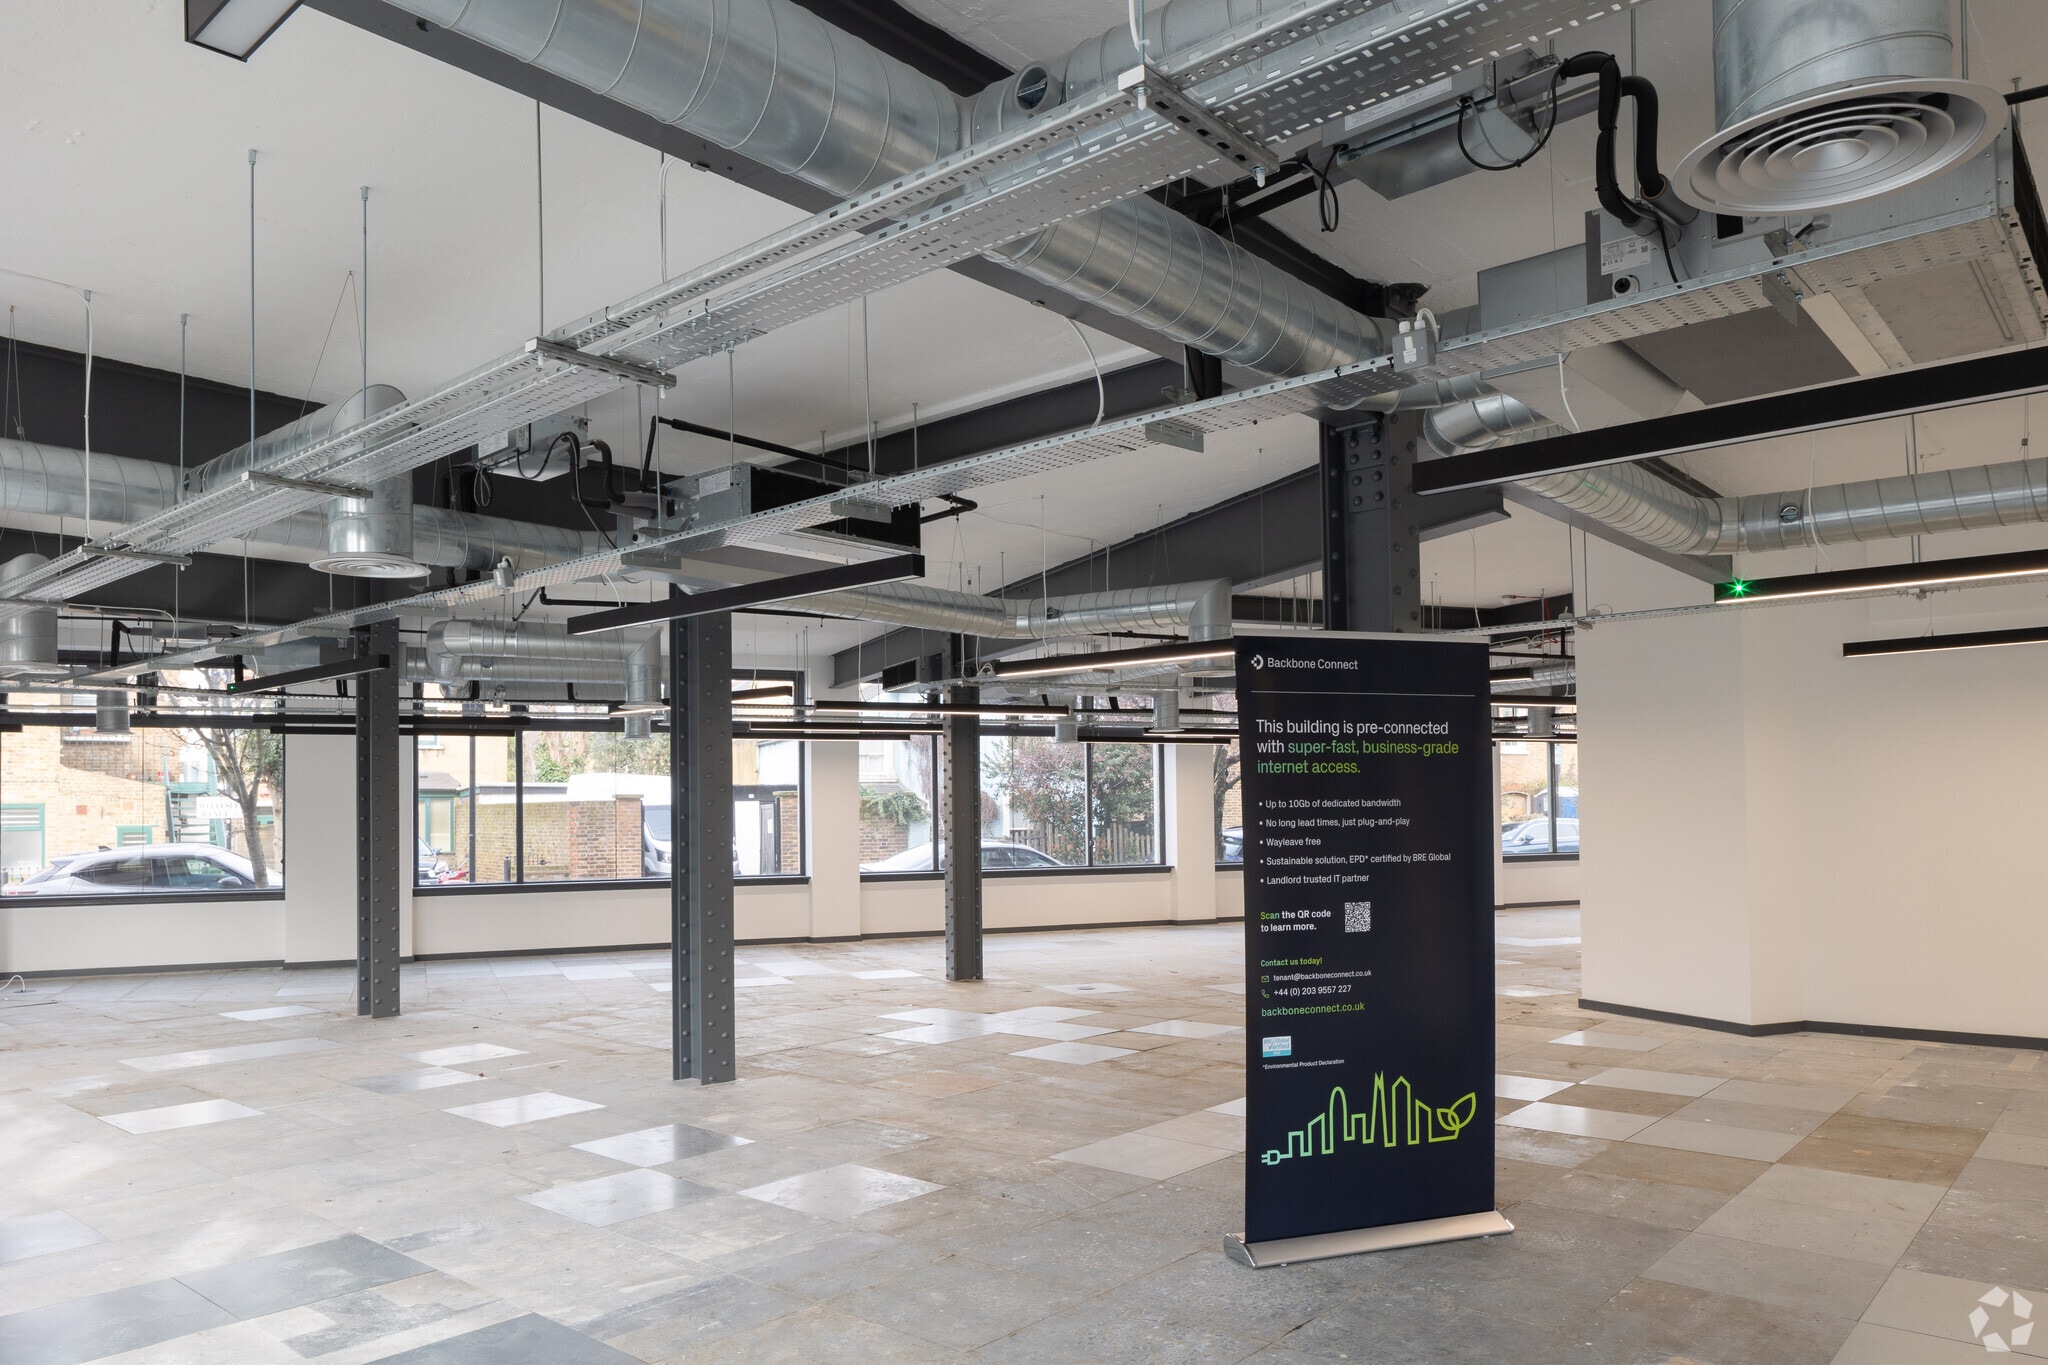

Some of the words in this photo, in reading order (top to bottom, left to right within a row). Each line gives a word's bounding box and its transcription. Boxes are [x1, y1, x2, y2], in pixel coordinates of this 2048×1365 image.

[1267, 658, 1316, 669] Backbone
[1317, 659, 1358, 670] Connect
[1256, 719, 1284, 734] This
[1287, 720, 1340, 736] building
[1343, 721, 1354, 734] is
[1356, 721, 1449, 736] pre-connected
[1257, 740, 1285, 754] with
[1288, 740, 1359, 756] super-fast,
[1362, 740, 1459, 757] business-grade
[1258, 760, 1309, 774] internet
[1311, 760, 1361, 774] access.
[1265, 799, 1277, 809] Up
[1288, 799, 1310, 808] 10Gb
[1312, 799, 1320, 808] of
[1322, 798, 1360, 808] dedicated
[1361, 798, 1401, 807] bandwidth
[1266, 818, 1277, 828] No
[1278, 818, 1296, 829] long
[1297, 818, 1316, 827] lead
[1317, 818, 1340, 828] times,
[1342, 817, 1356, 828] just
[1358, 817, 1410, 827] plug-and-play
[1266, 837, 1304, 848] Wayleave
[1305, 837, 1321, 846] free
[1266, 856, 1313, 866] Sustainable
[1314, 855, 1348, 865] solution,
[1370, 854, 1402, 863] certified
[1403, 853, 1412, 864] by
[1412, 853, 1427, 862] BRE
[1428, 852, 1451, 861] Global
[1267, 875, 1302, 885] Landlord
[1303, 875, 1332, 884] trusted
[1333, 875, 1340, 883] IT
[1342, 874, 1370, 884] partner
[1260, 911, 1280, 920] Scan
[1281, 911, 1296, 919] the
[1297, 910, 1310, 919] QR
[1311, 910, 1332, 918] code
[1270, 924, 1291, 932] learn
[1300, 957, 1323, 966] today!
[1273, 969, 1372, 982] tenant@backboneconnect.co.uk
[1290, 988, 1301, 997] (0)
[1302, 987, 1317, 995] 203
[1318, 986, 1336, 995] 9557
[1338, 985, 1352, 993] 227
[1261, 1002, 1365, 1017] backboneconnect.co.uk
